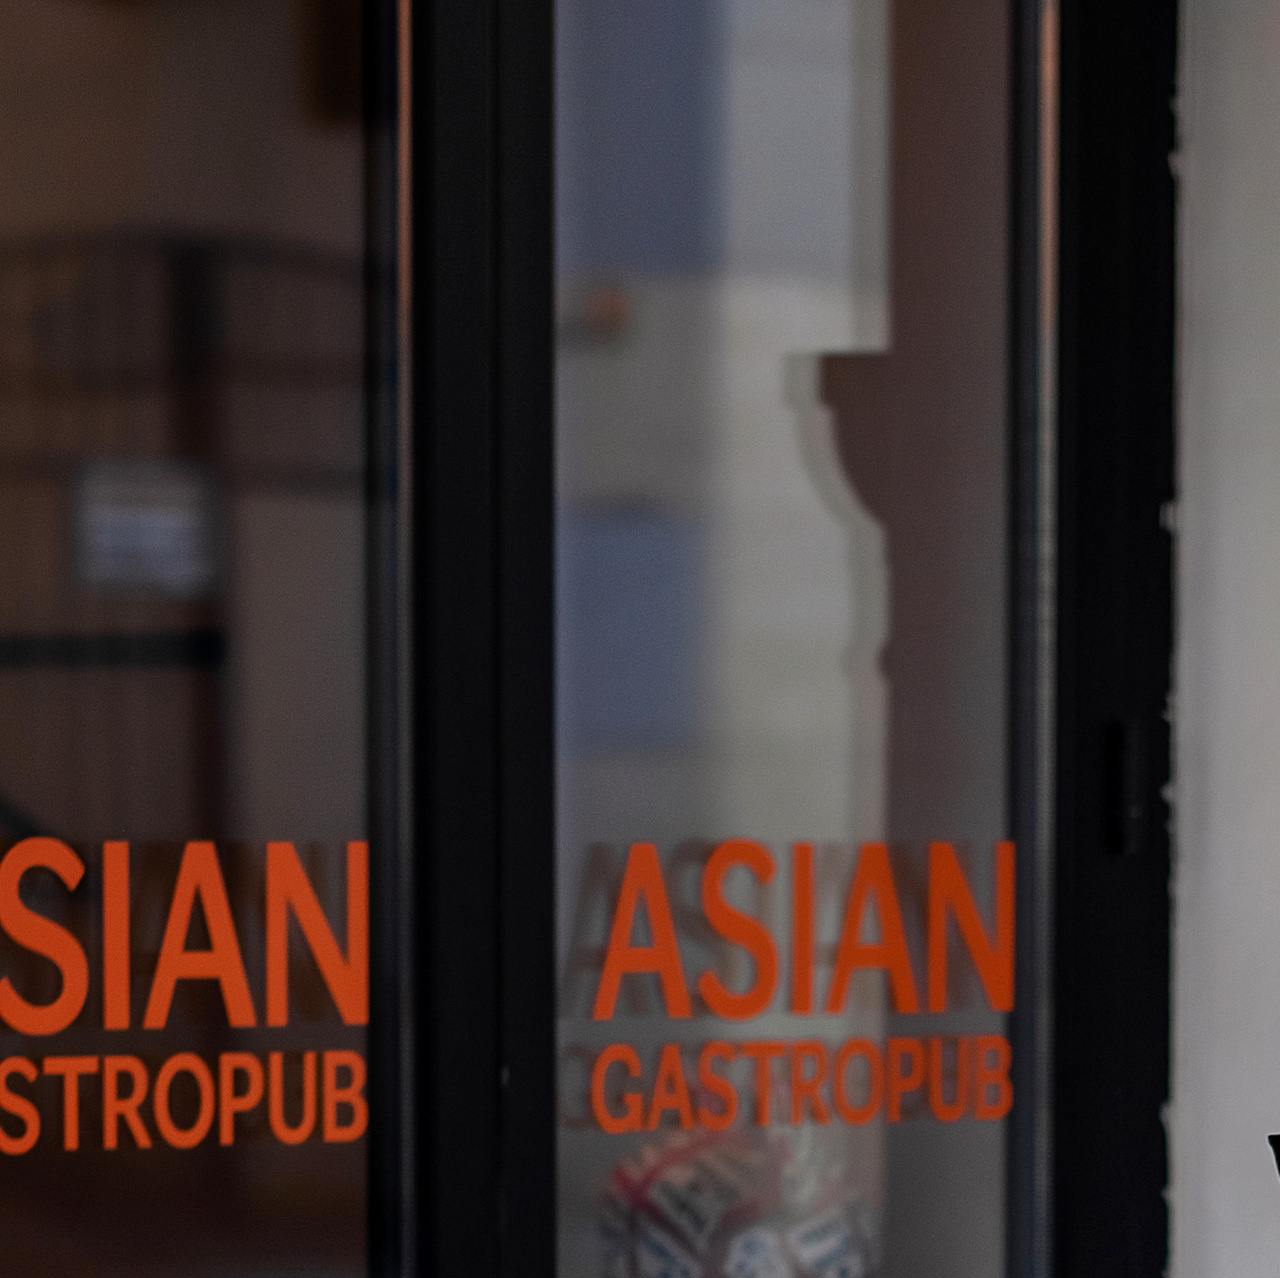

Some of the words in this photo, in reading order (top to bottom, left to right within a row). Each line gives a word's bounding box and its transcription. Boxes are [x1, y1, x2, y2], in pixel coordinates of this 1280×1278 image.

[0, 837, 369, 1036] SIAN
[592, 839, 1016, 1021] ASIAN
[0, 1051, 369, 1155] STROPUB
[590, 1036, 1014, 1134] GASTROPUB
